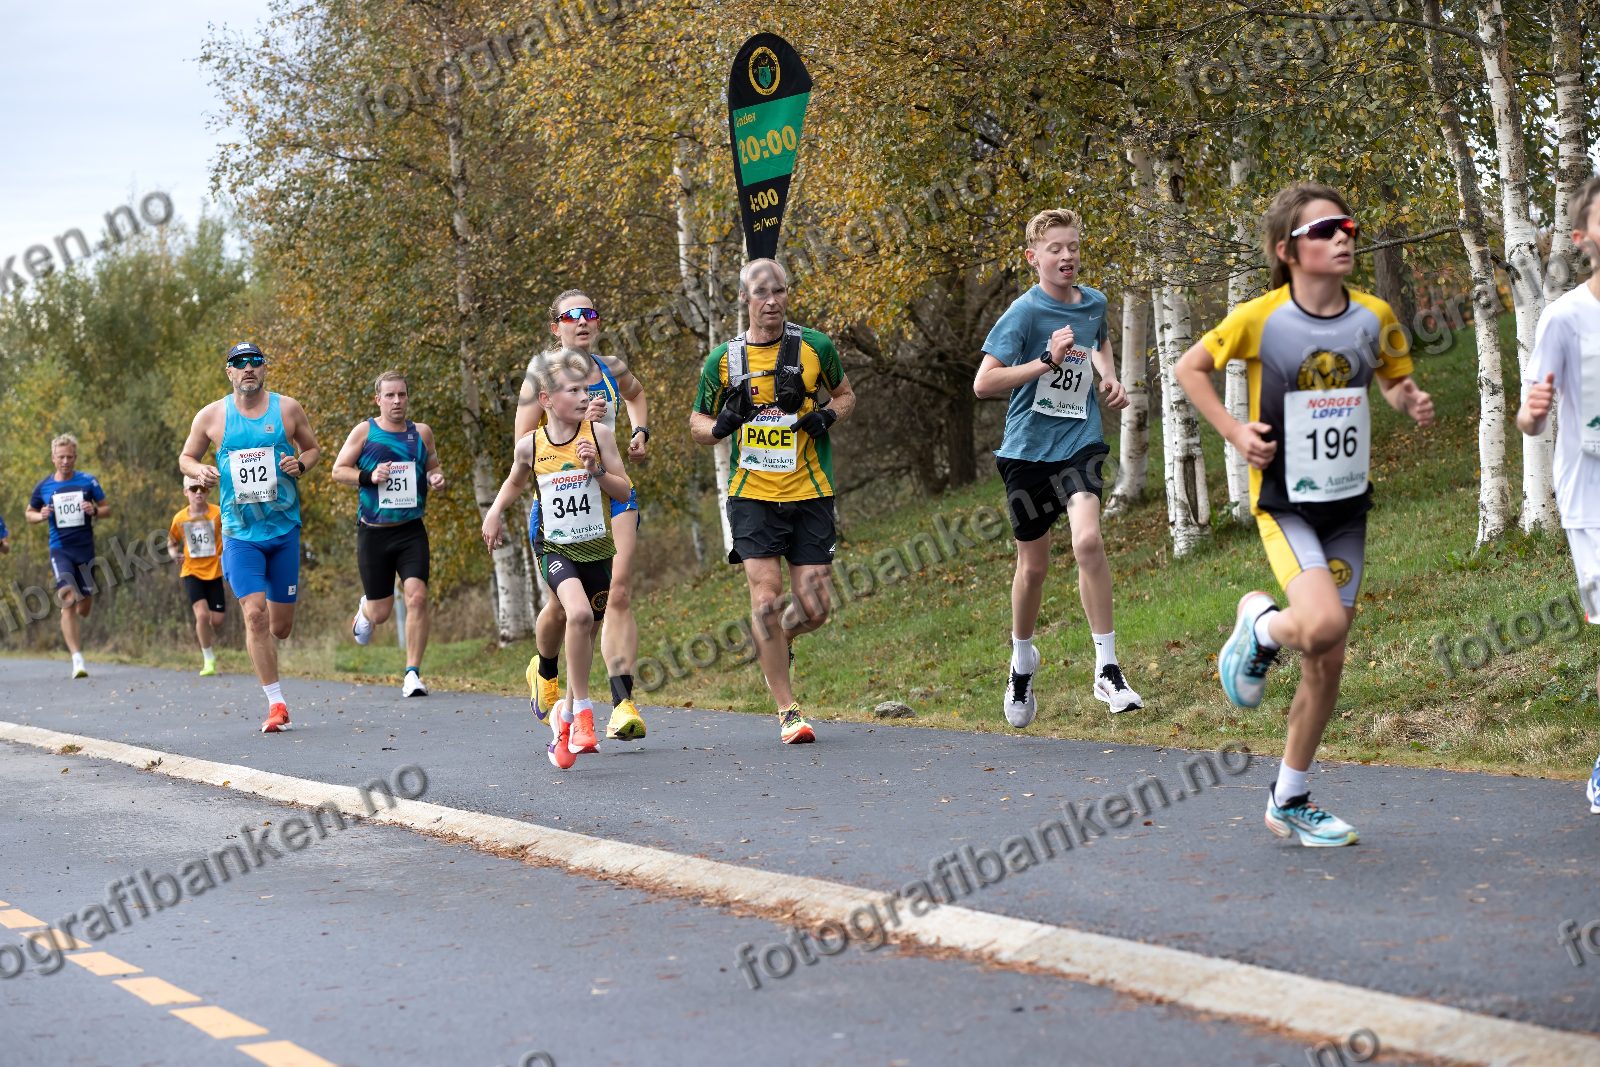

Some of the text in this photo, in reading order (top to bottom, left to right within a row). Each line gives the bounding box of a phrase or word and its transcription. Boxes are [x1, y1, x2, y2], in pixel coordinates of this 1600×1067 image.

[1065, 348, 1087, 359] ORGE
[1064, 355, 1085, 365] ØPET
[1050, 368, 1082, 392] 281
[1307, 396, 1362, 409] NORGES
[1312, 407, 1354, 419] LØPET
[747, 428, 792, 446] PACE
[1306, 426, 1358, 460] 196
[239, 465, 268, 484] 912
[552, 474, 588, 485] NORGES
[385, 477, 408, 492] 251
[555, 481, 583, 492] LØPET
[57, 503, 82, 515] 1004
[552, 494, 591, 519] 344
[190, 533, 210, 545] 945
